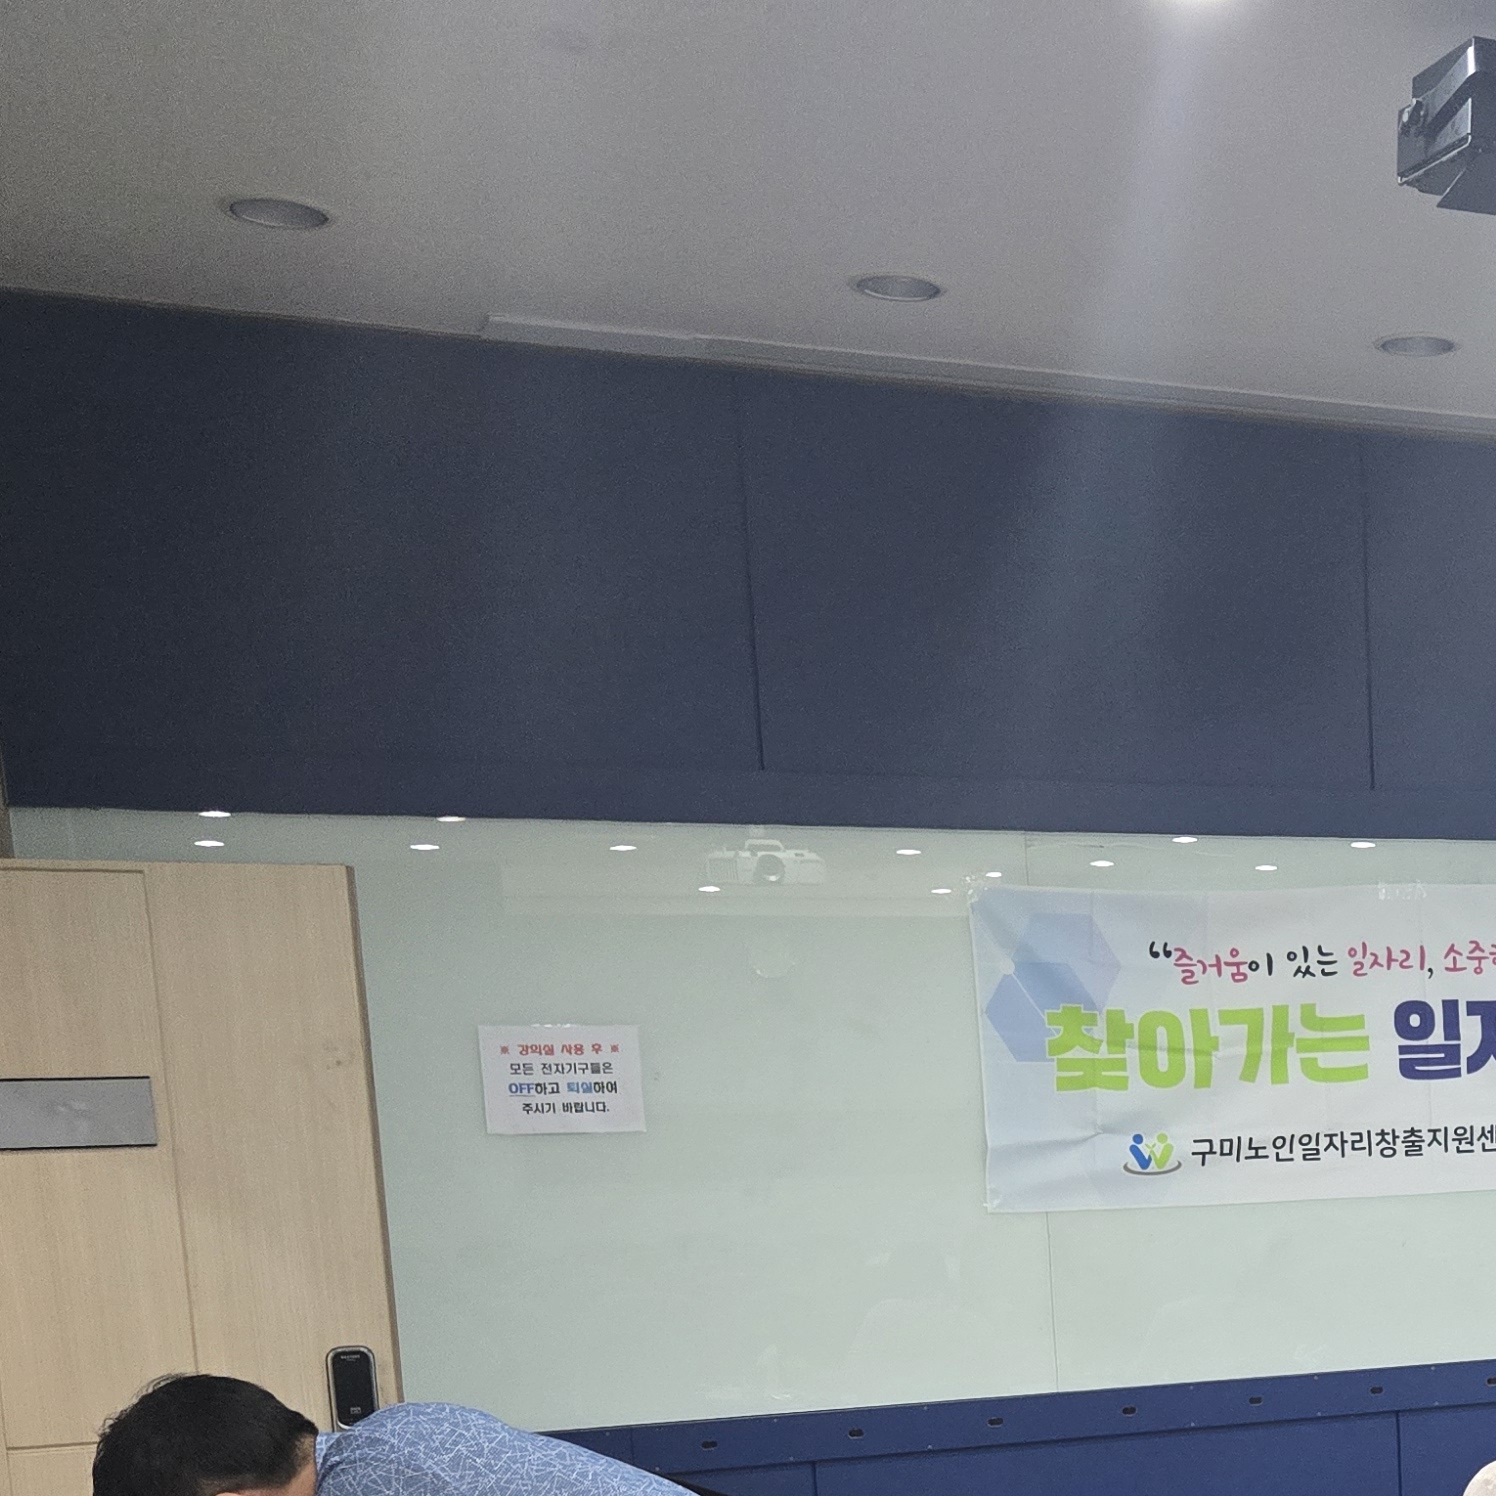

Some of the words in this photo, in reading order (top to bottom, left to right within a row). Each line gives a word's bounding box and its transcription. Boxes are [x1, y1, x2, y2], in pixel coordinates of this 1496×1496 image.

[1149, 941, 1273, 985] “즐거움이
[1286, 945, 1338, 978] 있는
[1347, 941, 1434, 979] 일자리,
[517, 1043, 555, 1056] 강의실
[561, 1043, 585, 1055] 사용
[591, 1043, 603, 1055] 후
[1046, 1003, 1370, 1091] 찾아가는
[509, 1063, 534, 1075] 모든
[541, 1062, 614, 1075] 전자기구들은
[508, 1082, 560, 1095] OFF하고
[567, 1081, 618, 1094] 퇴실하여
[522, 1102, 556, 1115] 주시기
[562, 1101, 610, 1114] 바랍니다.
